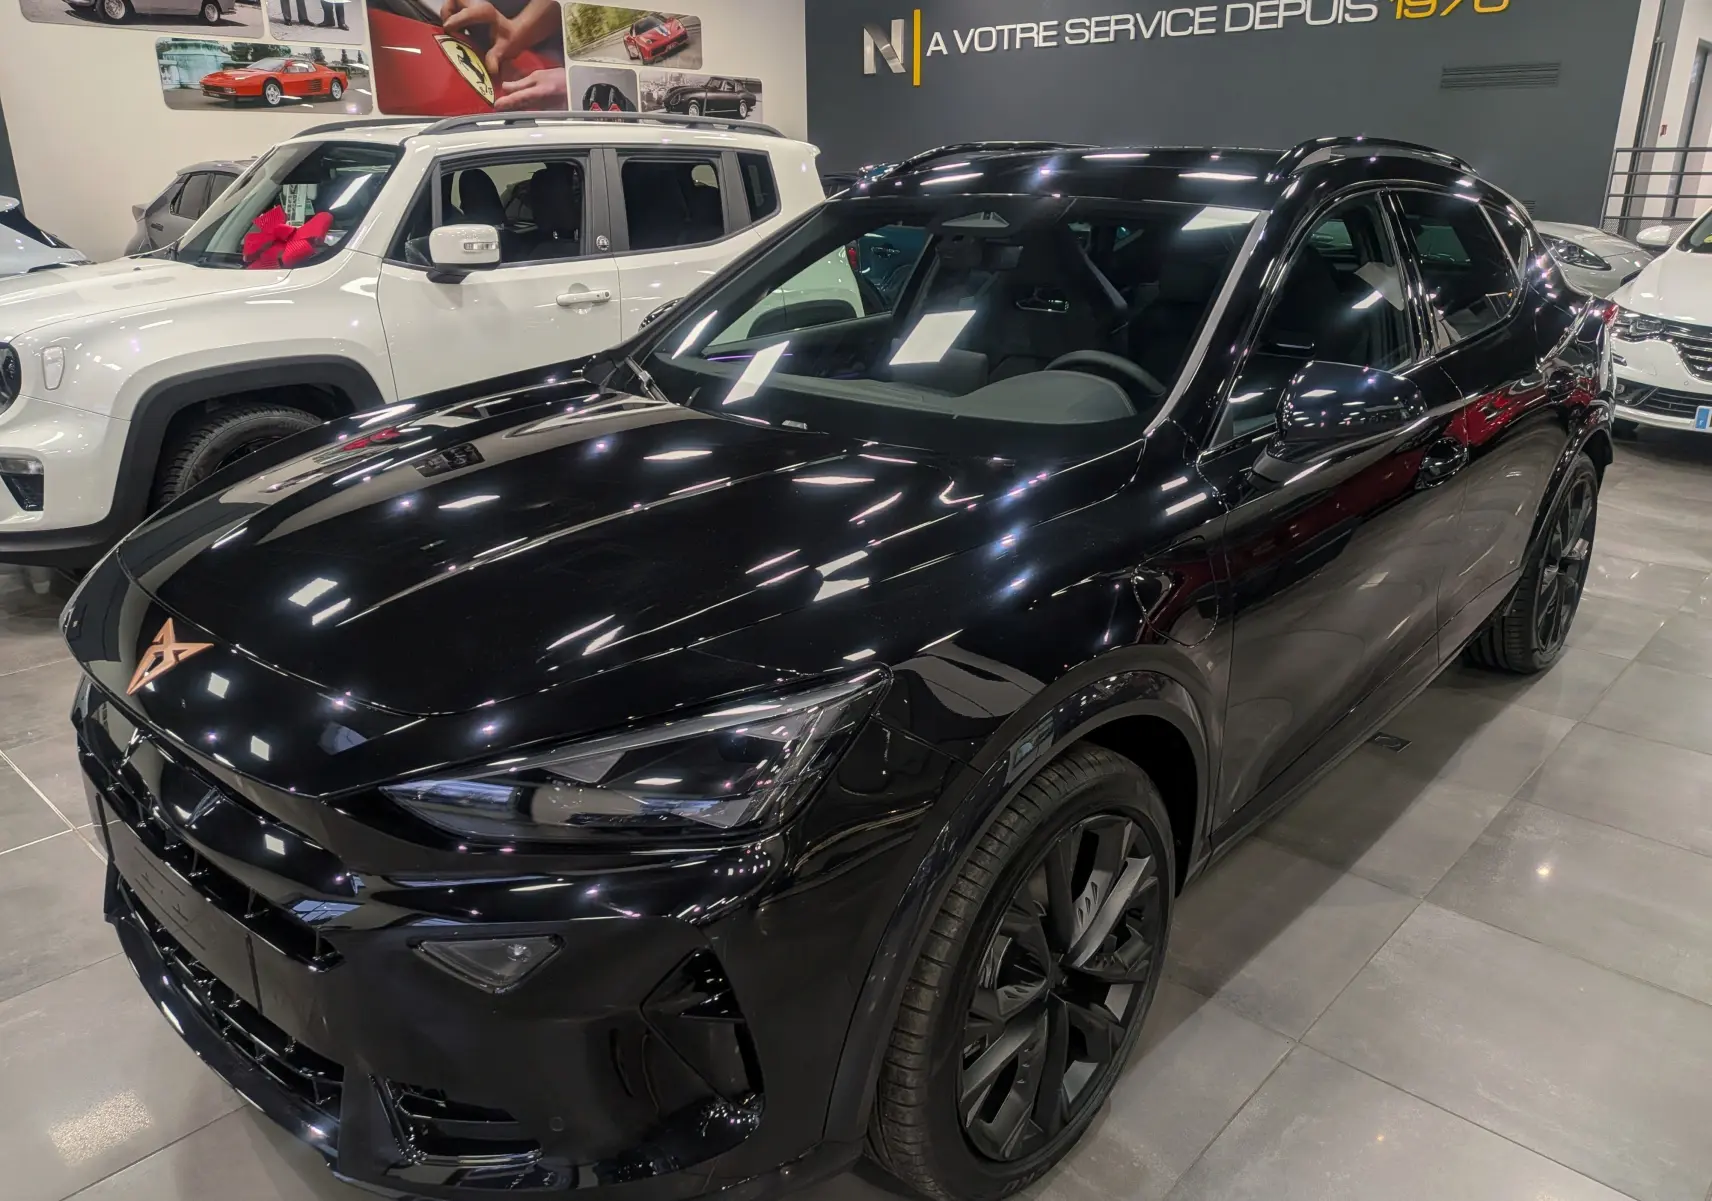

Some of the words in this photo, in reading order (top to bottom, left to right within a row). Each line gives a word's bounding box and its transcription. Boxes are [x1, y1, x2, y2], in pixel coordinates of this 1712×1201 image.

[863, 18, 907, 75] N
[925, 32, 949, 57] A
[953, 20, 1060, 54] VOTRE
[1064, 5, 1218, 45] SERVICE
[1224, 0, 1379, 33] DEPUIS
